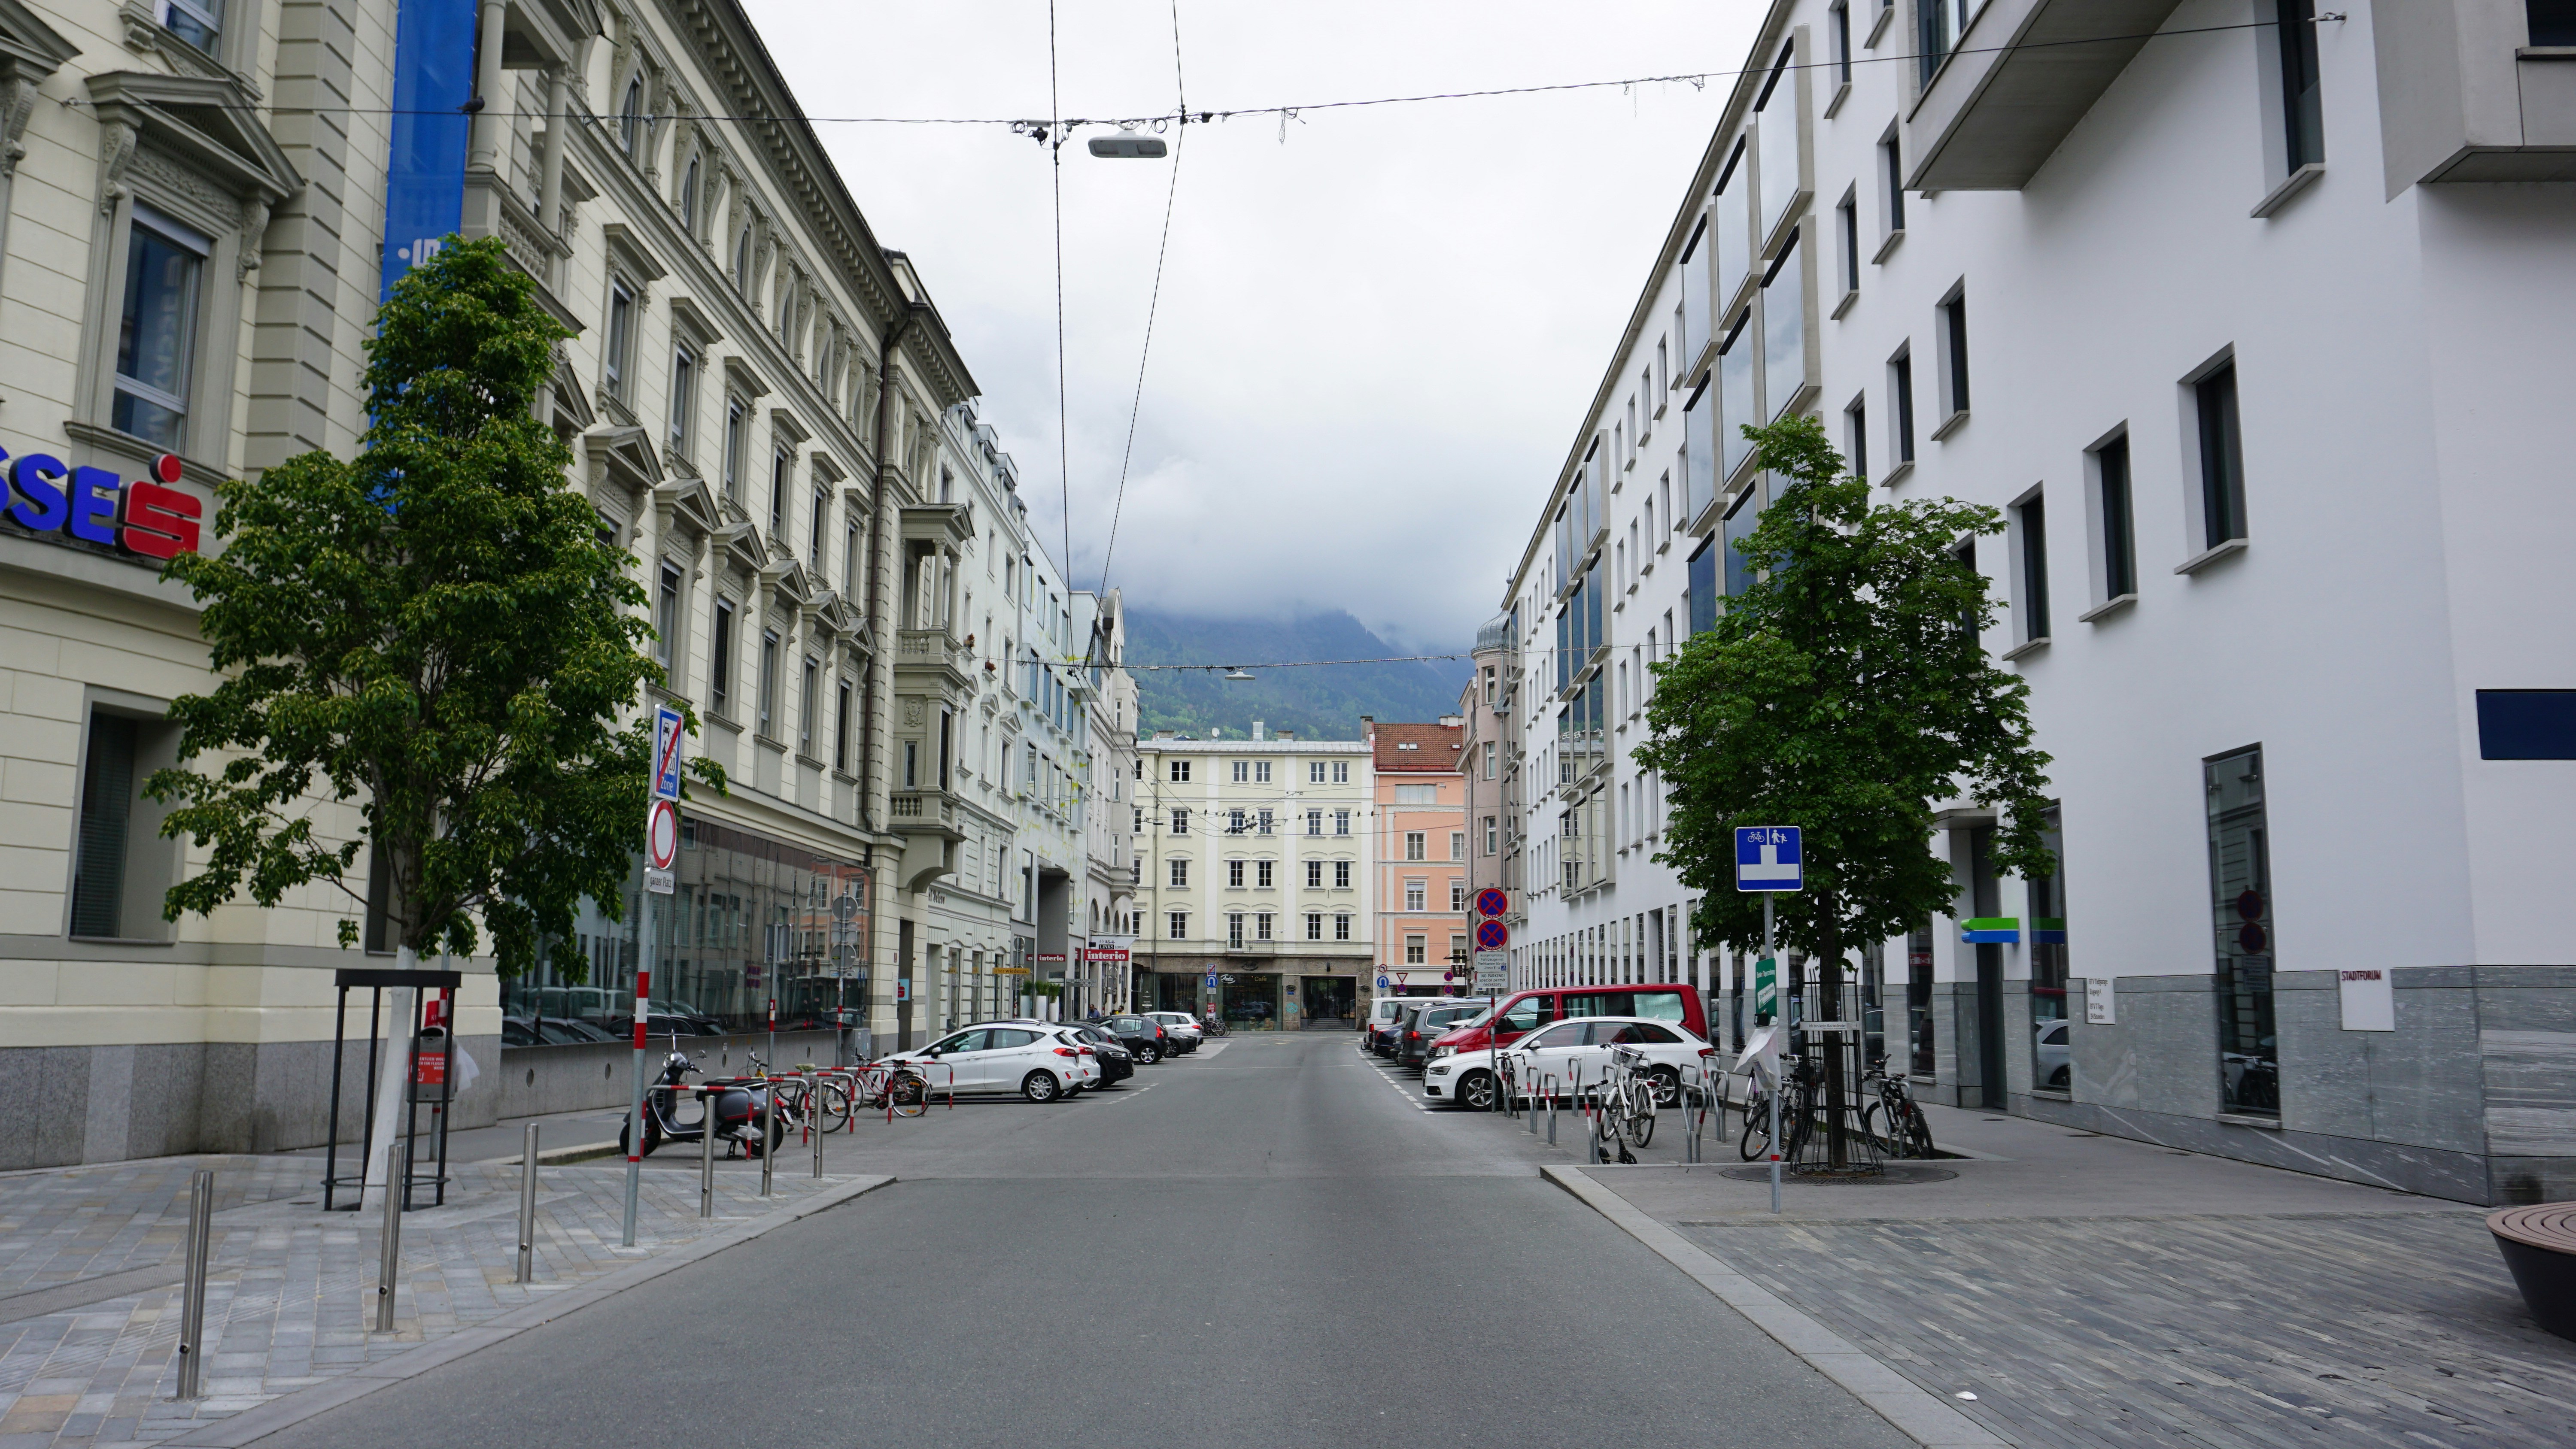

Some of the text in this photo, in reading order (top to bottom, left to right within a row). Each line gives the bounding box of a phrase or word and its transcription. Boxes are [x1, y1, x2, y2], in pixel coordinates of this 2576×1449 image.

[0, 445, 120, 545] SE
[669, 756, 676, 772] 20
[660, 776, 673, 792] Zone
[650, 876, 672, 888] ganzer Platz
[1087, 951, 1126, 960] interio
[2342, 970, 2382, 981] STADTFORUM
